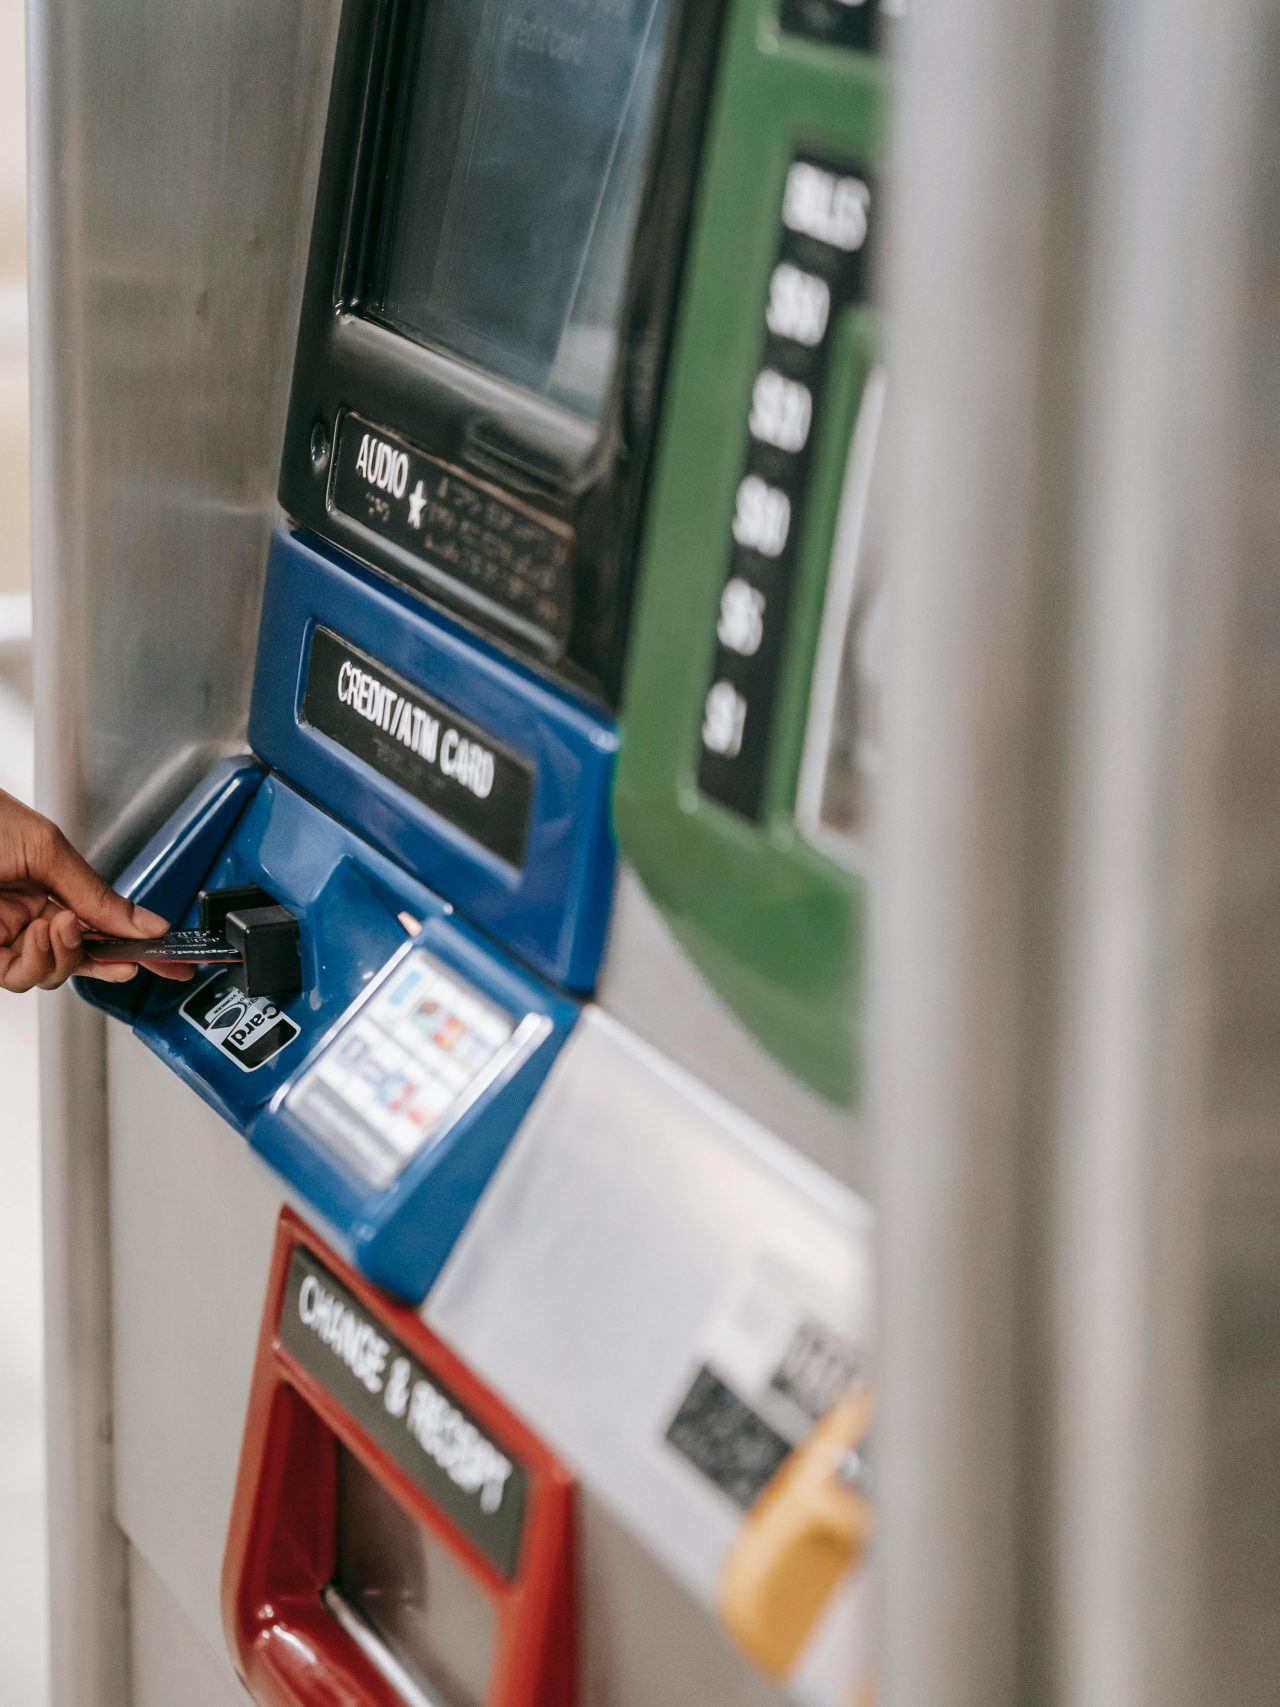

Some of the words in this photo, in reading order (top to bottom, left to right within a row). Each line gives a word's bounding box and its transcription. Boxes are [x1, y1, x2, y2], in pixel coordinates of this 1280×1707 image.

[355, 433, 409, 499] AUDIO
[337, 661, 440, 763] CREDIT/ATM
[439, 729, 495, 799] CARD
[231, 1003, 281, 1046] Card
[298, 1274, 390, 1394] CHANGE
[384, 1357, 412, 1418] &
